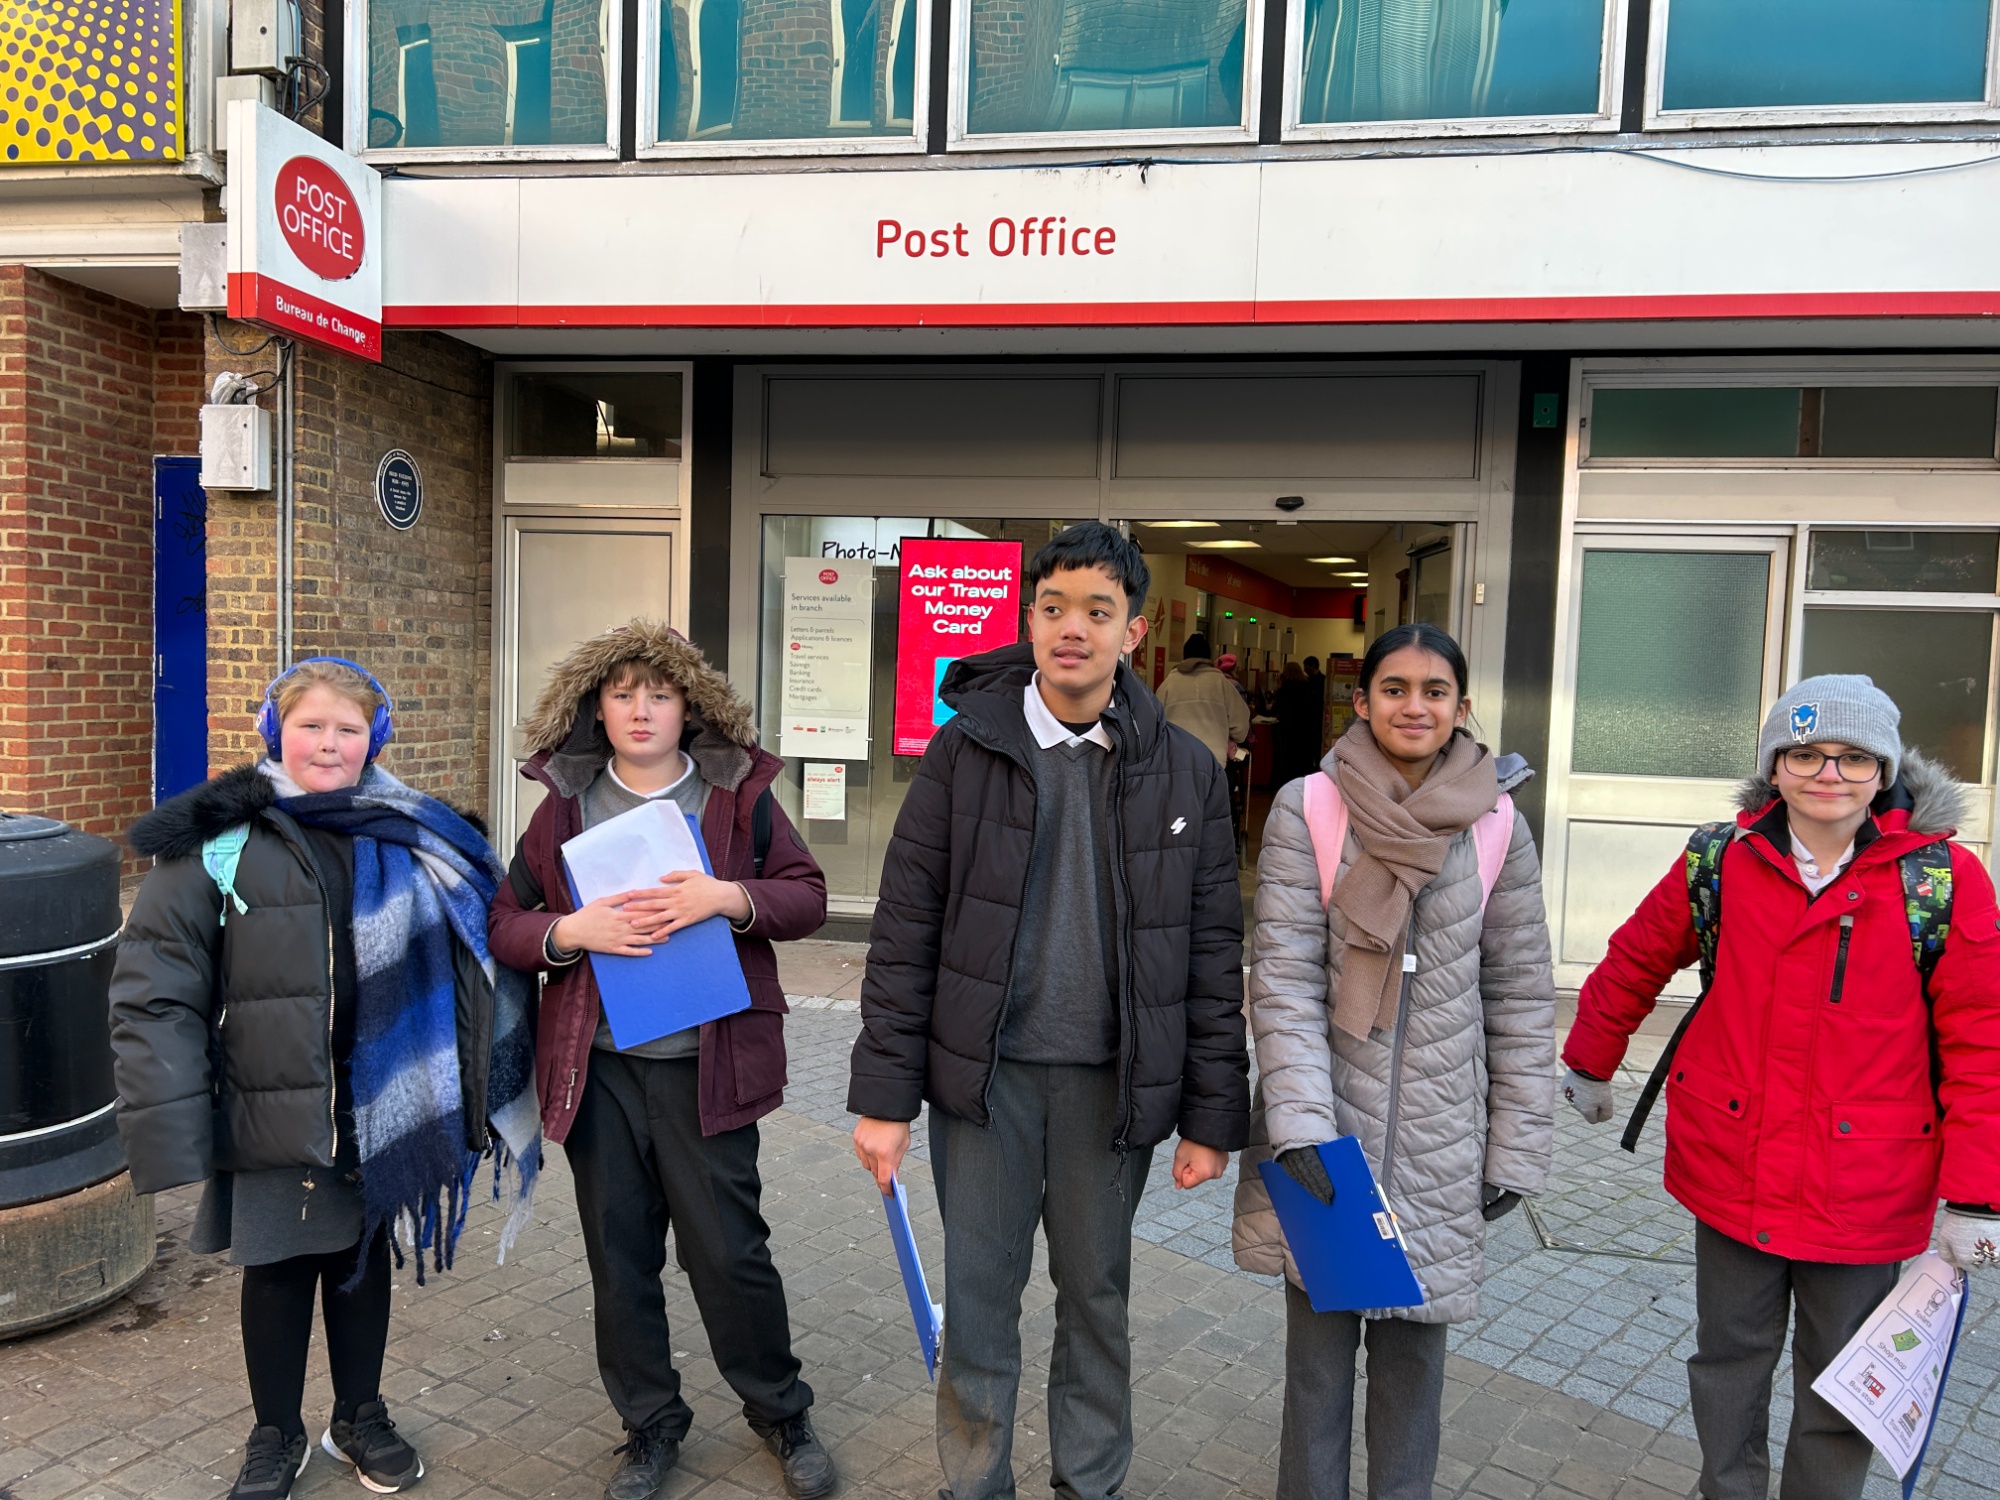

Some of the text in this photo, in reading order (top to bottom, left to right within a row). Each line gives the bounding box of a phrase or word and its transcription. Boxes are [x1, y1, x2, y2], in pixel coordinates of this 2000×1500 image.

[296, 176, 347, 224] POST
[283, 203, 354, 260] OFFICE
[877, 216, 1116, 259] Post Office
[276, 295, 366, 344] Bureau de Change
[908, 563, 1012, 581] Ask about
[791, 593, 852, 602] Services available
[911, 583, 1008, 599] our Travel
[799, 603, 823, 611] branch
[924, 600, 993, 620] Money
[932, 619, 982, 635] Card
[789, 661, 811, 669] Savings
[789, 669, 811, 677] Banking
[788, 694, 817, 702] Mortgages
[1914, 1309, 1932, 1329] Toilets
[1877, 1342, 1907, 1371] Shop map
[1848, 1380, 1875, 1406] Bus stop
[1887, 1418, 1900, 1436] Train
